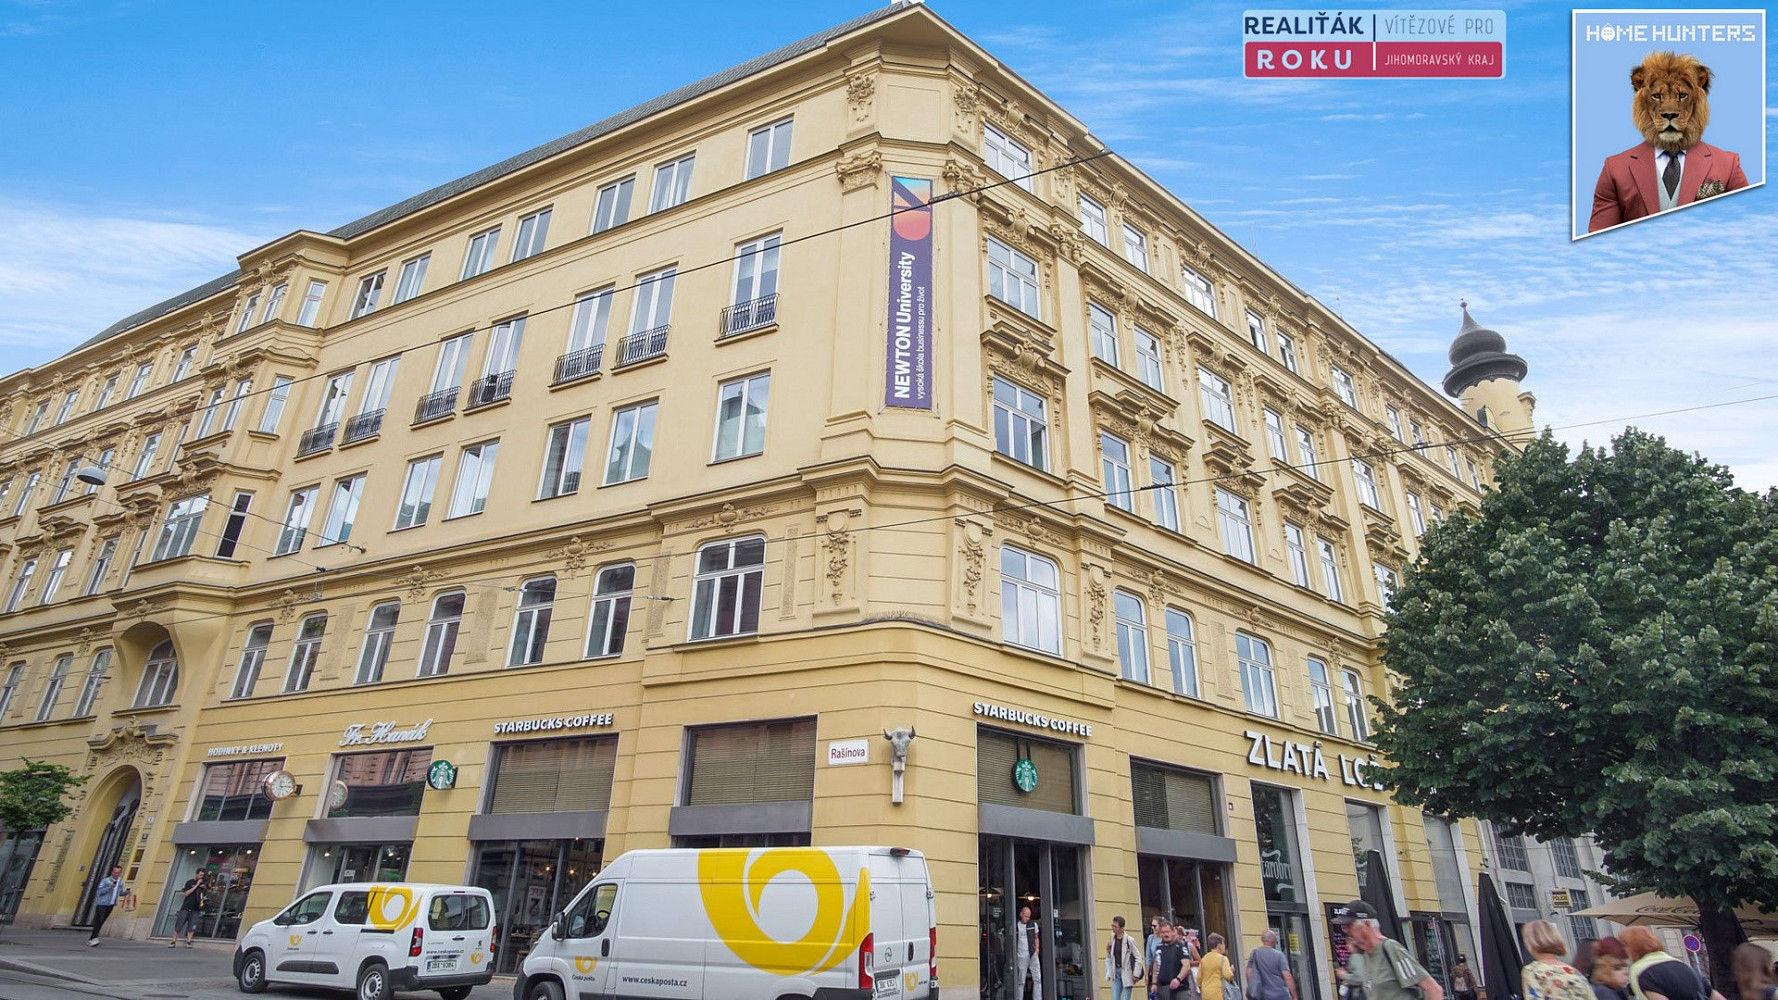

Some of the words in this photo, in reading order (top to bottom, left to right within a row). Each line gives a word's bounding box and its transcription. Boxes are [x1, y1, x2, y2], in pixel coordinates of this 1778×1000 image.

[897, 252, 915, 322] University
[918, 303, 926, 316] pro
[894, 325, 911, 399] NEWTON
[493, 718, 564, 734] STARBUCKS
[565, 713, 614, 728] COFFEE
[973, 701, 1048, 728] STARBUCKS
[1050, 717, 1092, 737] COFFEE
[207, 746, 240, 757] HODINKY
[248, 742, 284, 754] KLENOTY
[831, 748, 865, 759] Rašínova
[1245, 730, 1330, 781] ZLATÁ
[622, 975, 688, 987] www.ceskaposta.cz
